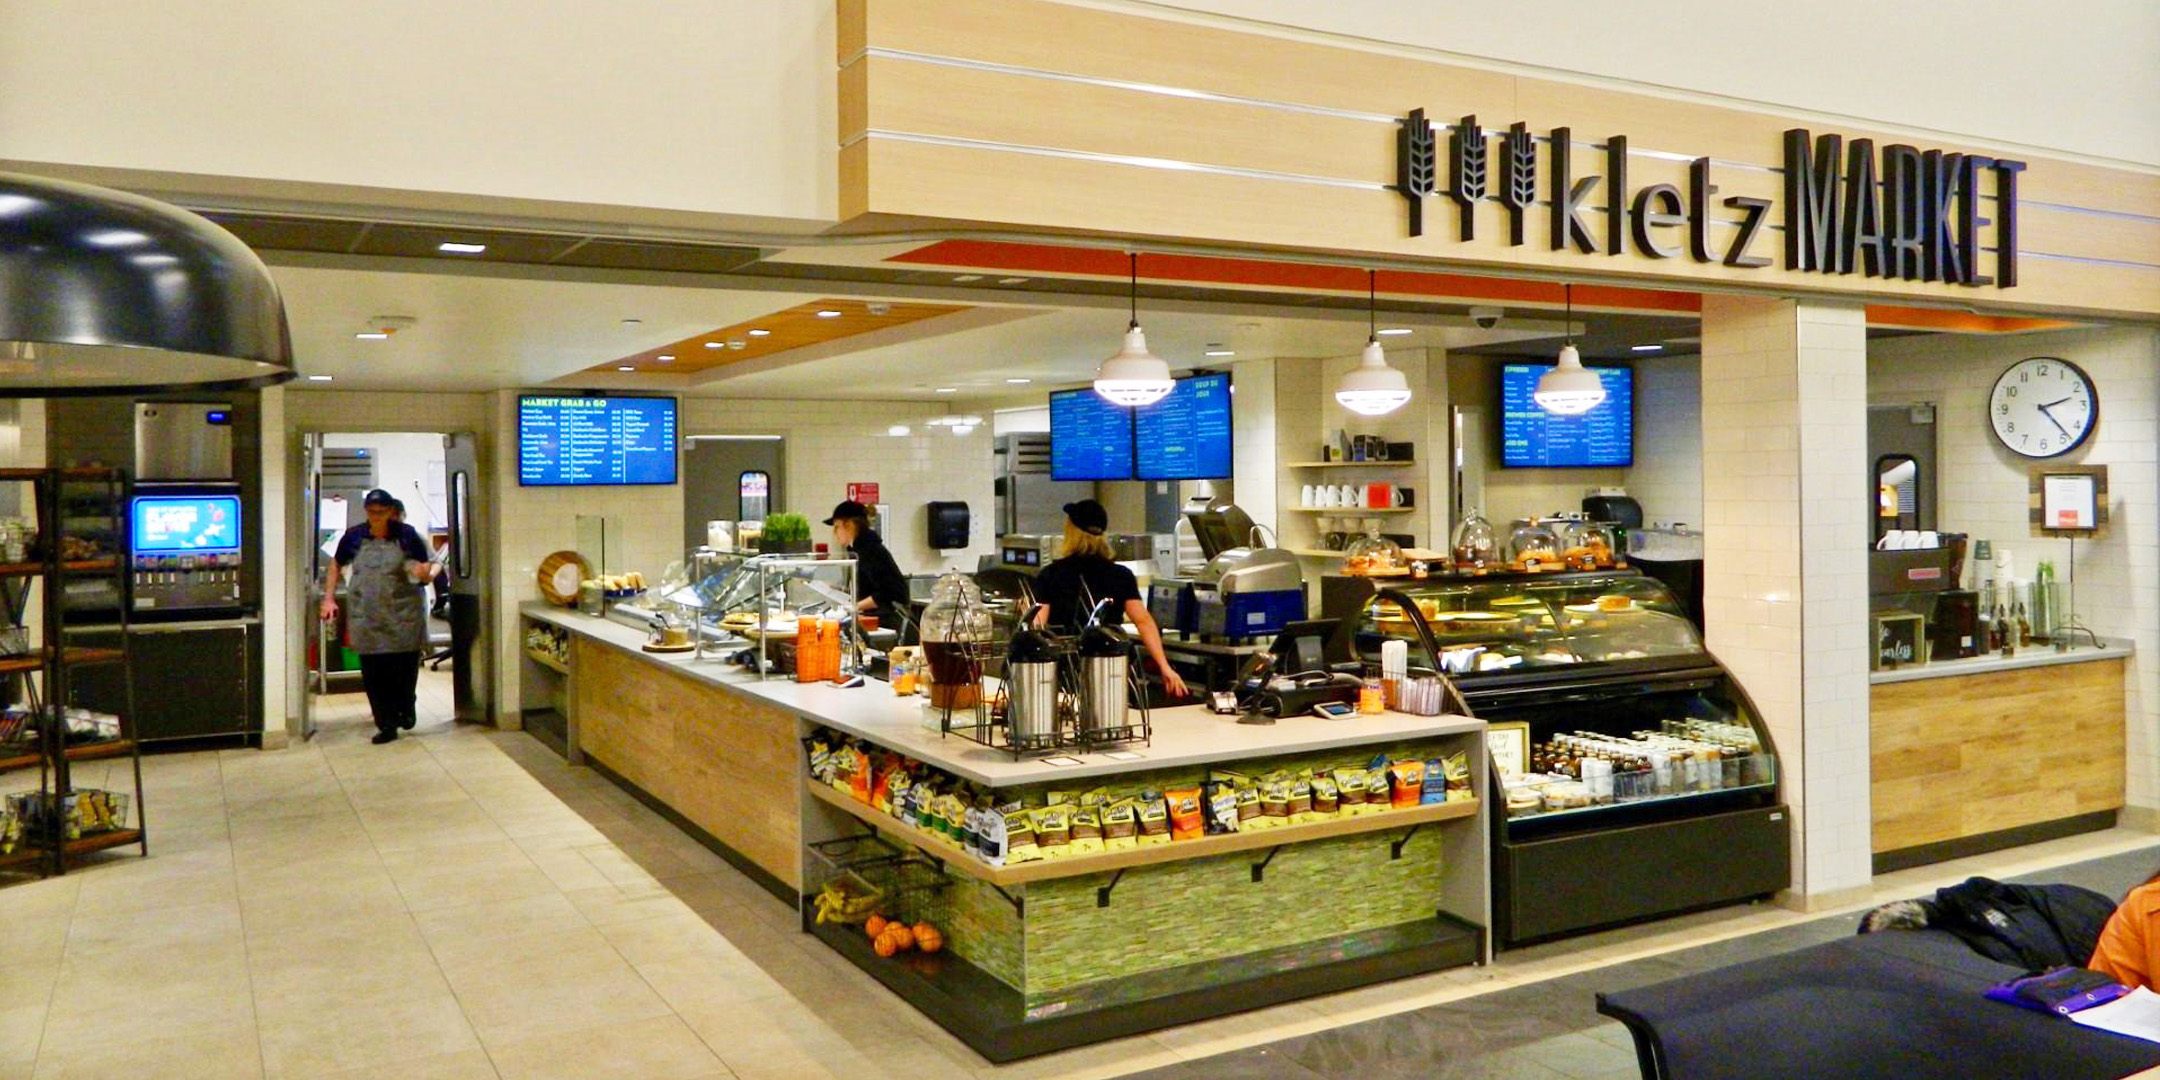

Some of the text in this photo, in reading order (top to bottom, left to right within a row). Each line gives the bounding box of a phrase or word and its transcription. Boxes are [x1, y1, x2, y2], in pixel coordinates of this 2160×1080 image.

[1550, 126, 2027, 288] kletz MARKET
[2036, 365, 2048, 376] 12
[2020, 372, 2028, 382] 11
[2006, 386, 2018, 397] 10
[2073, 381, 2080, 393] 2
[522, 399, 559, 407] MARKET
[560, 399, 584, 407] GRAB
[592, 399, 607, 407] GO
[2080, 400, 2087, 411] 3
[2001, 404, 2008, 415] 9
[2007, 422, 2015, 433] 8
[2073, 420, 2080, 430] 4
[2021, 434, 2028, 445] 7
[2060, 432, 2067, 444] 5
[2040, 439, 2047, 450] 6
